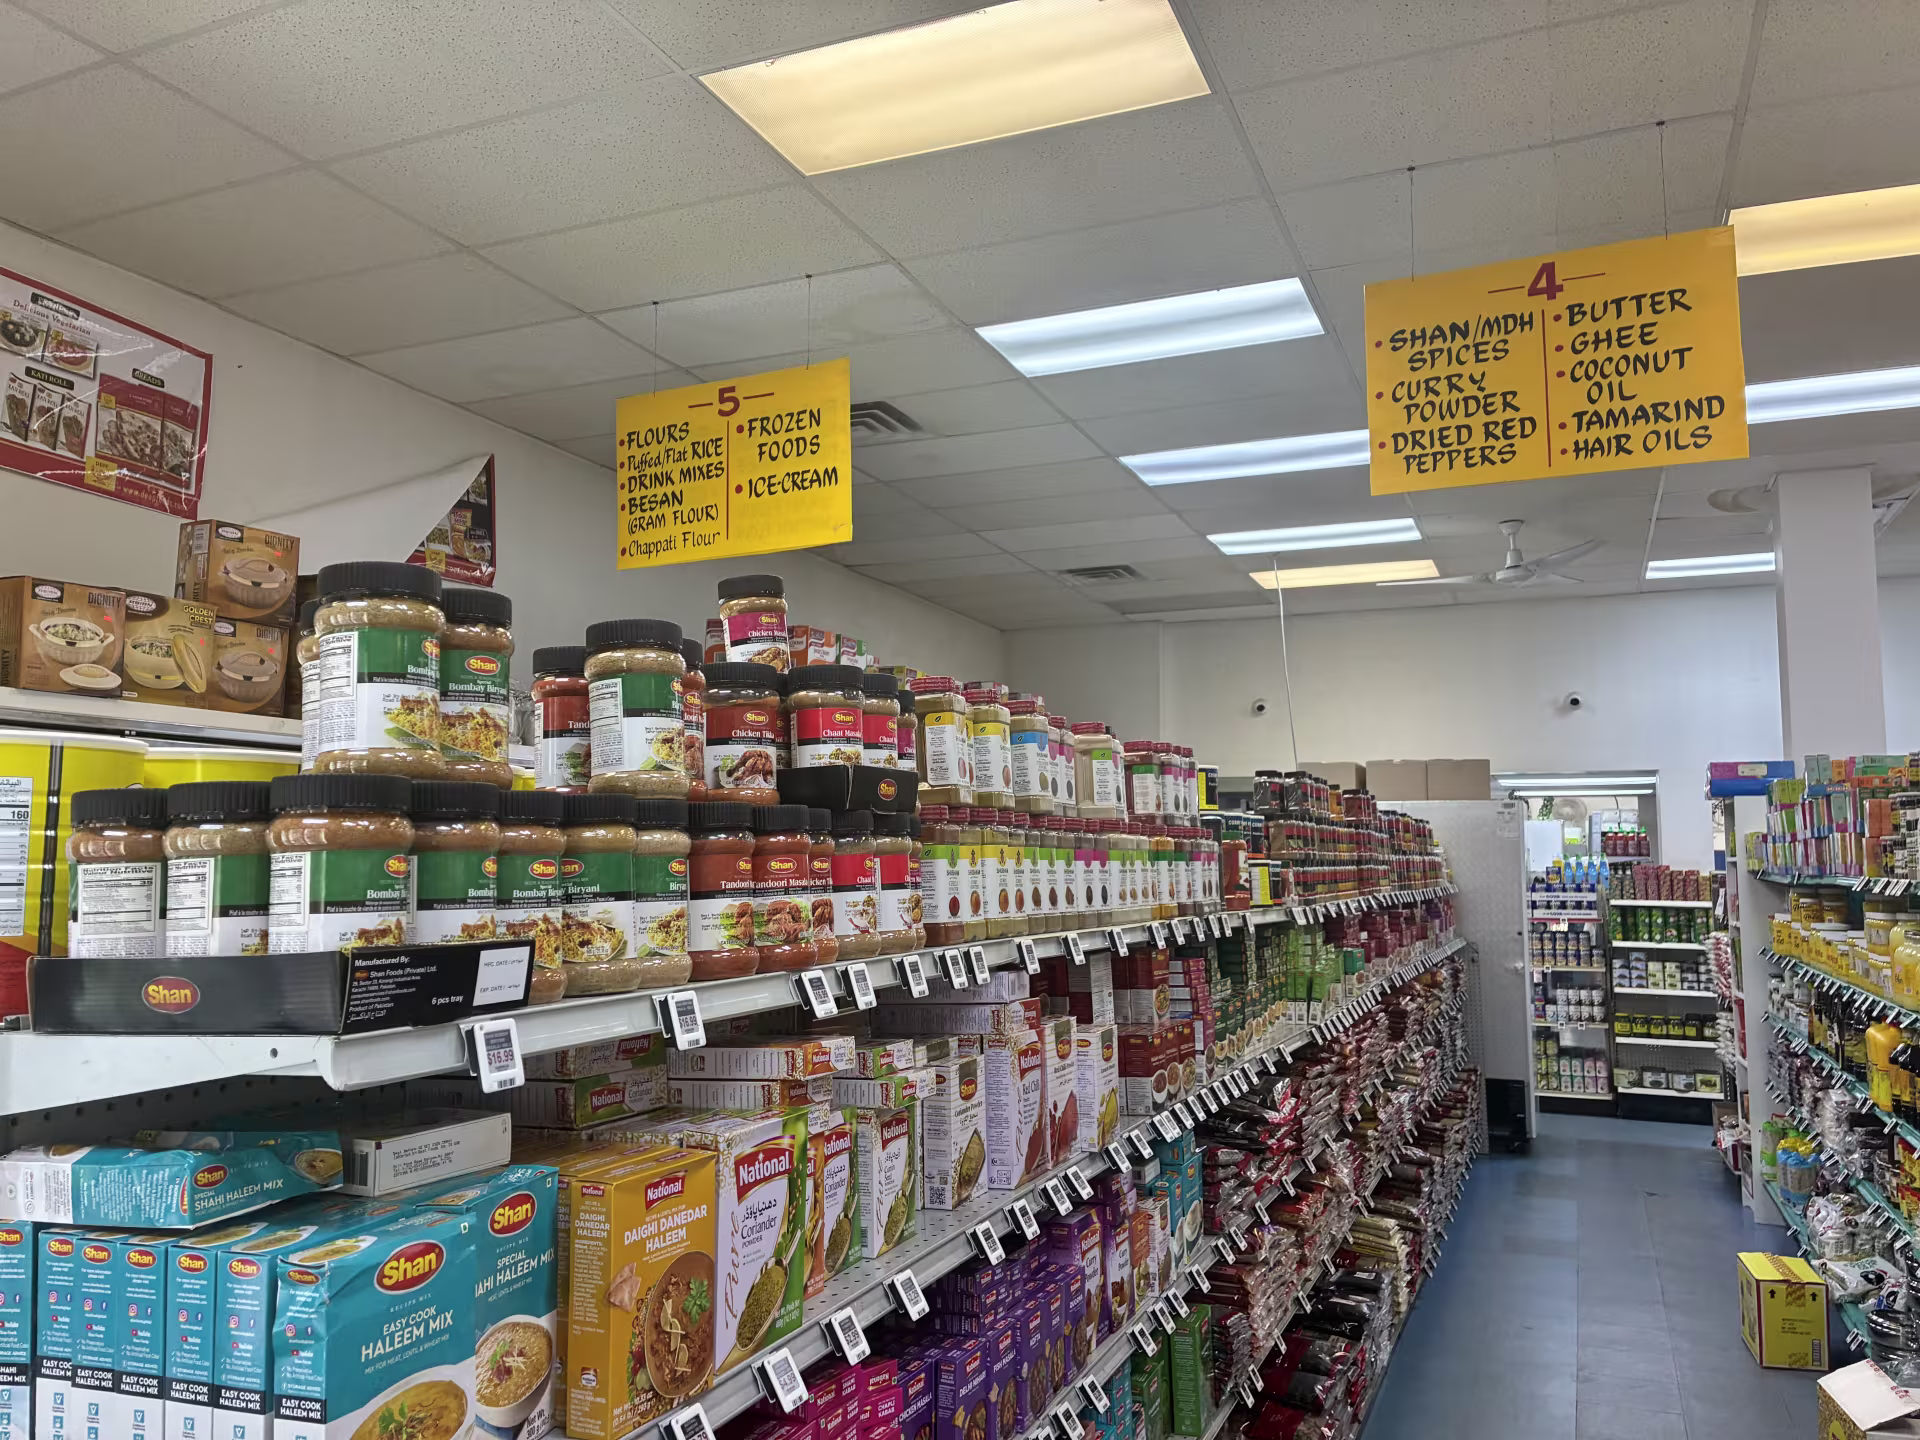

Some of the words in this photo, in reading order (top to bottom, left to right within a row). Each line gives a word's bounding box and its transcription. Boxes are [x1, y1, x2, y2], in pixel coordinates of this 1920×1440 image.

[1527, 262, 1563, 300] 4
[1566, 288, 1692, 326] BUTTER
[1389, 311, 1534, 353] SHAN/MDH
[1570, 322, 1658, 355] GHEE
[1408, 339, 1509, 372] SPICES
[1570, 347, 1693, 383] COCONUT
[1392, 371, 1486, 402] CURRY
[1587, 380, 1637, 404] OIL
[718, 386, 740, 417] 5
[1404, 391, 1521, 424] POWDER
[748, 408, 821, 438] FROZEN
[1572, 396, 1725, 434] TAMARIND
[627, 422, 690, 450] FLOURS
[1392, 425, 1473, 455] DRIED
[1485, 416, 1537, 441] RED
[1573, 434, 1633, 462] HAIR
[1643, 425, 1712, 453] OILS
[628, 445, 687, 473] Puffed/Flat
[691, 437, 723, 459] RICE
[757, 435, 821, 463] FOODS
[1404, 444, 1517, 475] PEPPERS
[628, 469, 675, 494] DRINK
[679, 461, 724, 485] MIXES
[748, 467, 838, 499] ICE-CREAM
[628, 490, 684, 515] BESAN
[628, 513, 666, 536] (GRAM
[672, 504, 718, 527] FLOUR)
[264, 534, 294, 551] DIGNITY
[628, 535, 676, 560] Chappati
[682, 531, 720, 549] Flour
[88, 592, 122, 608] DIGNITY
[184, 606, 214, 616] GOLDEN
[190, 614, 213, 624] CREST
[761, 615, 778, 623] Shan
[469, 659, 497, 671] Shan
[449, 683, 484, 692] Bombay
[746, 713, 766, 721] Shan
[835, 714, 853, 722] Shan
[732, 730, 760, 738] Chicken
[880, 784, 895, 796] Shan
[11, 810, 29, 820] 160
[533, 864, 555, 874] Shan
[771, 862, 793, 870] Shan
[513, 890, 547, 898] Bombay
[568, 884, 600, 894] Biryani
[355, 957, 398, 966] Manufactured
[370, 970, 384, 978] Shan
[404, 967, 426, 975] (Private)
[148, 985, 192, 1004] Shan
[438, 997, 449, 1006] pcs
[451, 995, 463, 1004] tray
[679, 1015, 698, 1027] $16.99
[487, 1050, 514, 1066] $16.99
[812, 1053, 830, 1062] National
[1020, 1050, 1041, 1069] National
[960, 1082, 976, 1097] Shan
[1022, 1083, 1030, 1095] Red
[592, 1091, 623, 1105] National
[883, 1120, 908, 1140] National
[195, 1169, 225, 1186] Shan
[739, 1152, 790, 1187] National
[583, 1187, 603, 1196] National
[647, 1179, 682, 1201] National
[825, 1178, 846, 1194] Coriander
[194, 1189, 215, 1200] SPECIAL
[195, 1193, 225, 1211] SHAHI
[226, 1184, 262, 1204] HALEEM
[263, 1178, 283, 1193] MIX
[494, 1202, 532, 1230] Shan
[580, 1213, 605, 1222] DAIGHI
[575, 1220, 610, 1230] DANEDAR
[624, 1221, 658, 1245] DAIGHI
[660, 1204, 707, 1231] DANEDAR
[741, 1215, 777, 1240] Coriander
[578, 1229, 607, 1238] HALEEM
[646, 1227, 686, 1253] HALEEM
[50, 1242, 73, 1253] Shan
[85, 1248, 108, 1259] Shan
[130, 1253, 153, 1264] Shan
[180, 1257, 204, 1269] Shan
[497, 1250, 526, 1269] SPECIAL
[497, 1256, 538, 1286] HALEEM
[540, 1247, 554, 1265] MIX
[231, 1262, 257, 1274] Shan
[382, 1250, 437, 1286] Shan
[289, 1272, 315, 1282] Shan
[383, 1318, 408, 1336] EASY
[409, 1305, 437, 1325] COOK
[361, 1321, 425, 1362] HALEEM
[429, 1310, 454, 1334] MIX
[41, 1368, 64, 1376] HALEEM
[43, 1360, 58, 1368] EASY
[78, 1369, 92, 1377] EASY
[93, 1371, 112, 1379] COOK
[76, 1377, 100, 1386] HALEEM
[101, 1380, 112, 1388] MIX
[172, 1382, 187, 1391] EASY
[189, 1385, 208, 1394] COOK
[171, 1390, 195, 1400] HALEEM
[196, 1393, 208, 1402] MIX
[282, 1398, 299, 1408] EASY
[300, 1400, 321, 1411] COOK
[900, 1402, 918, 1422] CHICKEN
[280, 1407, 307, 1418] HALEEM
[308, 1410, 321, 1419] MIX
